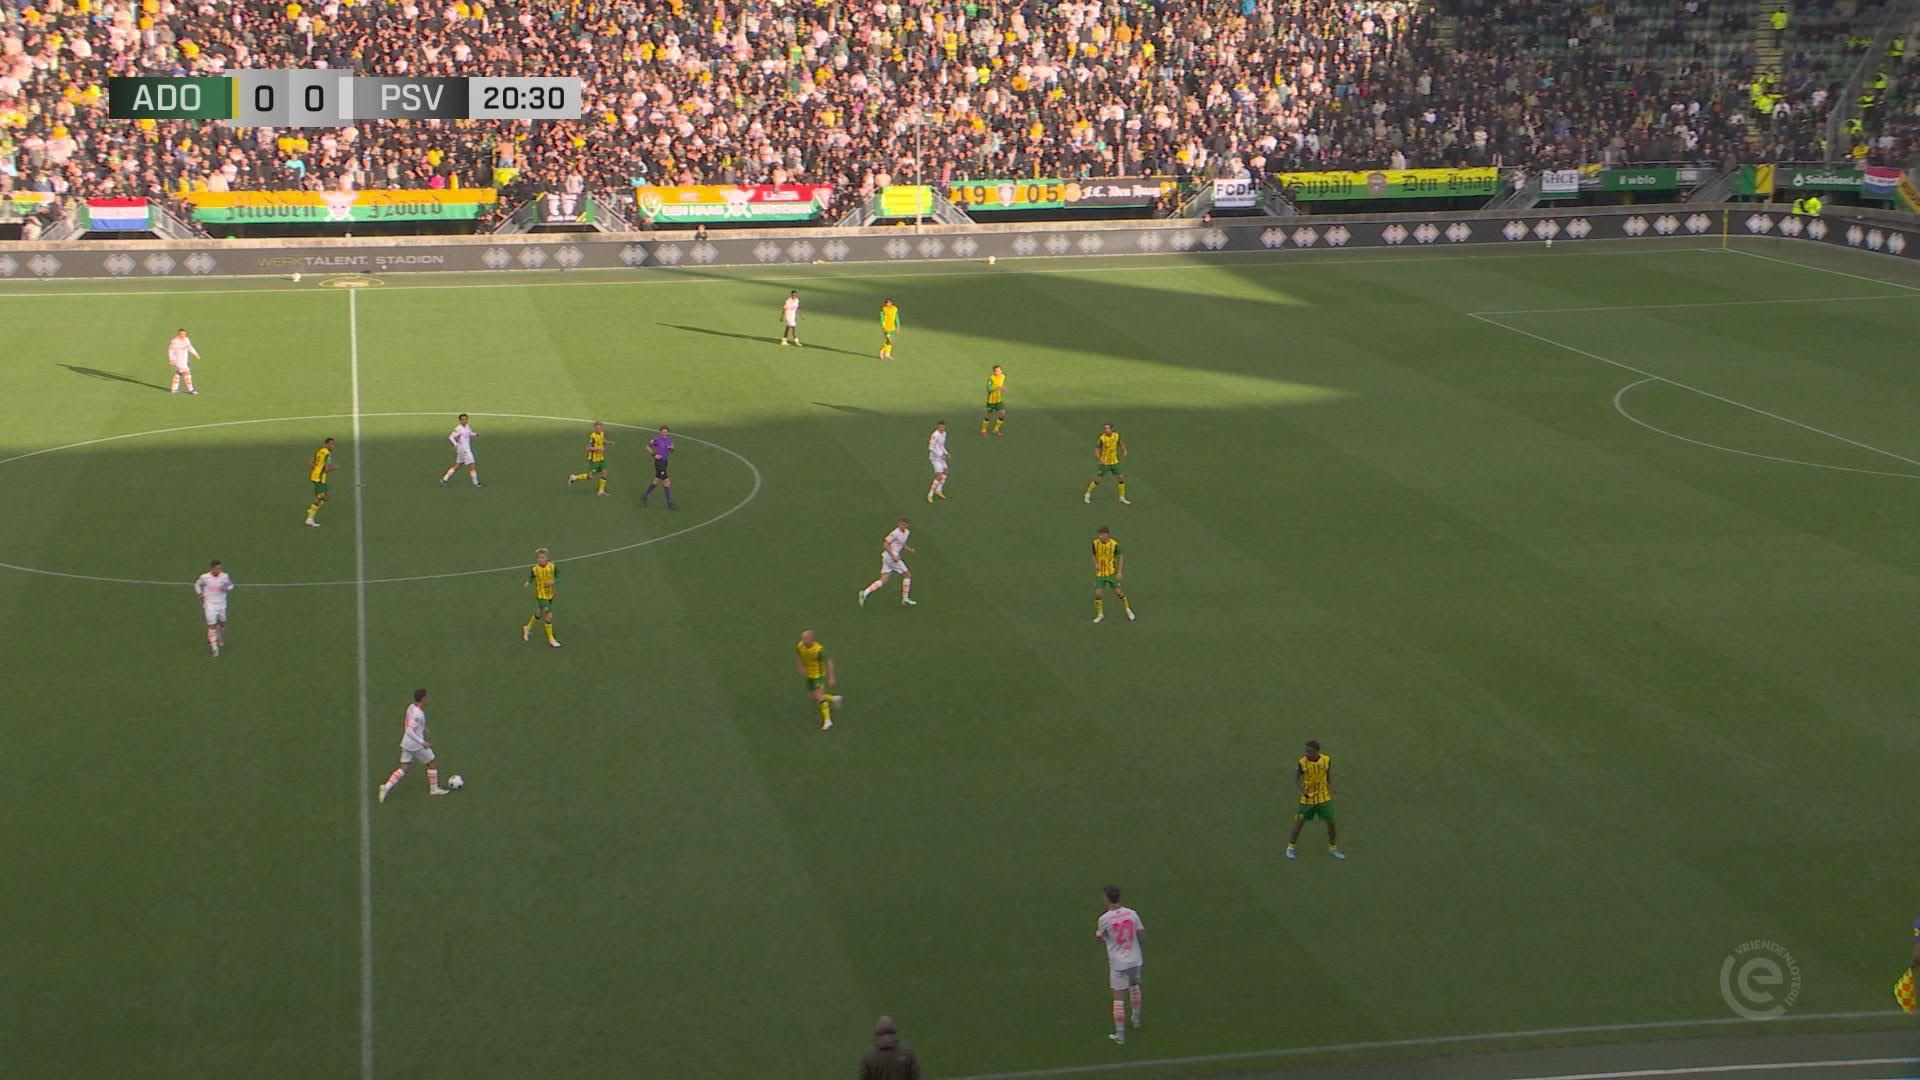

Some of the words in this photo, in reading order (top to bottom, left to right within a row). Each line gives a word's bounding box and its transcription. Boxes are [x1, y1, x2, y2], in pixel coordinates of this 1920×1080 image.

[1403, 174, 1438, 191] Den
[1447, 173, 1494, 193] Haag
[375, 255, 444, 265] STADION
